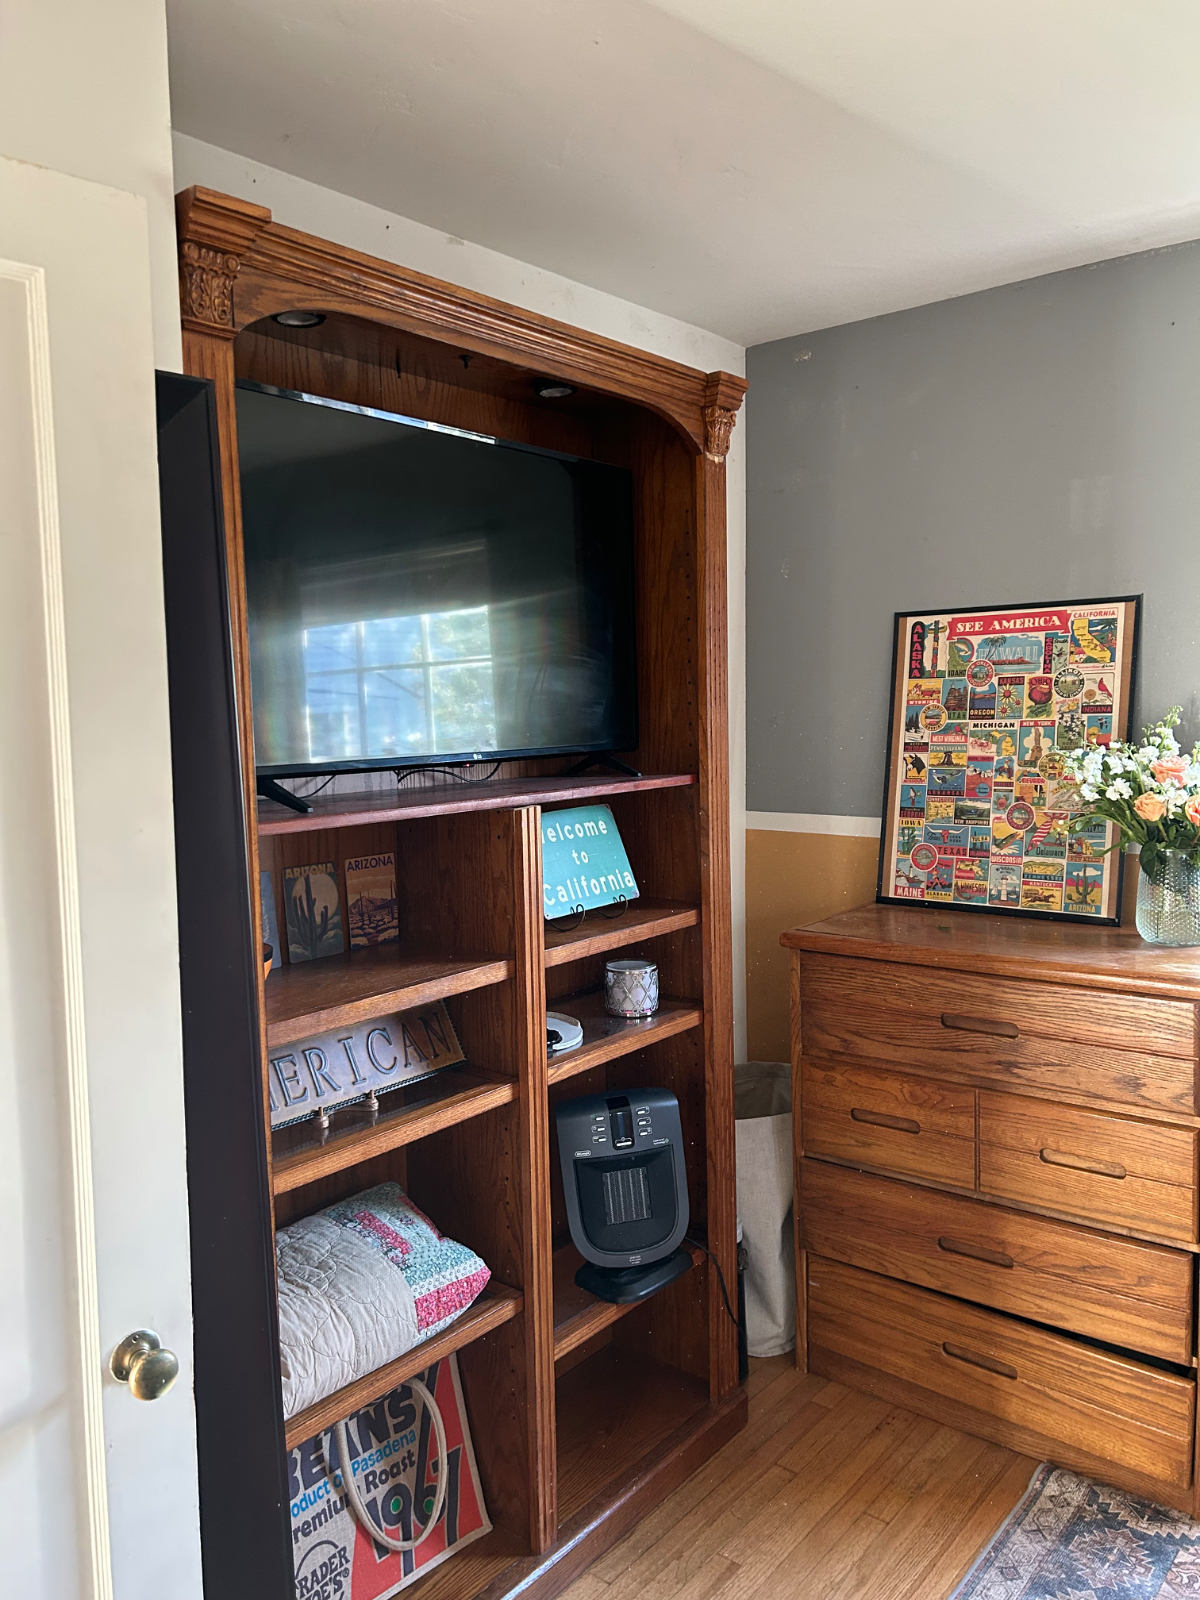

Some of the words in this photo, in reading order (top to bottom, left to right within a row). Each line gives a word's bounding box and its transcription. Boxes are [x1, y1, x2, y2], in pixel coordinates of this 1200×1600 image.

[1073, 610, 1116, 619] CALIFORNIA
[956, 621, 984, 633] SEE
[989, 615, 1062, 631] AMERICA
[911, 624, 924, 678] ALASKA
[978, 645, 1039, 660] HAWAII
[948, 669, 966, 677] IDAHO
[1055, 668, 1084, 681] ILLINOIS
[999, 677, 1024, 685] KANSAS
[1031, 678, 1052, 686] OHIO
[948, 711, 966, 719] UTAH
[1082, 705, 1111, 713] INDIANA
[932, 735, 944, 743] WEST
[944, 735, 966, 743] VIRGINIA
[541, 820, 607, 844] elcome
[572, 849, 588, 865] to
[938, 846, 967, 856] TEXAS
[1035, 846, 1064, 857] Delaware
[346, 855, 394, 872] ARIZONA
[285, 862, 335, 880] ARIZONA
[543, 869, 635, 906] California
[896, 886, 922, 898] MAINE
[1068, 904, 1096, 913] ARIZONA
[268, 1011, 452, 1112] ERICAN
[290, 1479, 330, 1518] oduct
[351, 1428, 417, 1478] Pasadena
[364, 1450, 416, 1495] Roast
[296, 1546, 351, 1600] RADER
